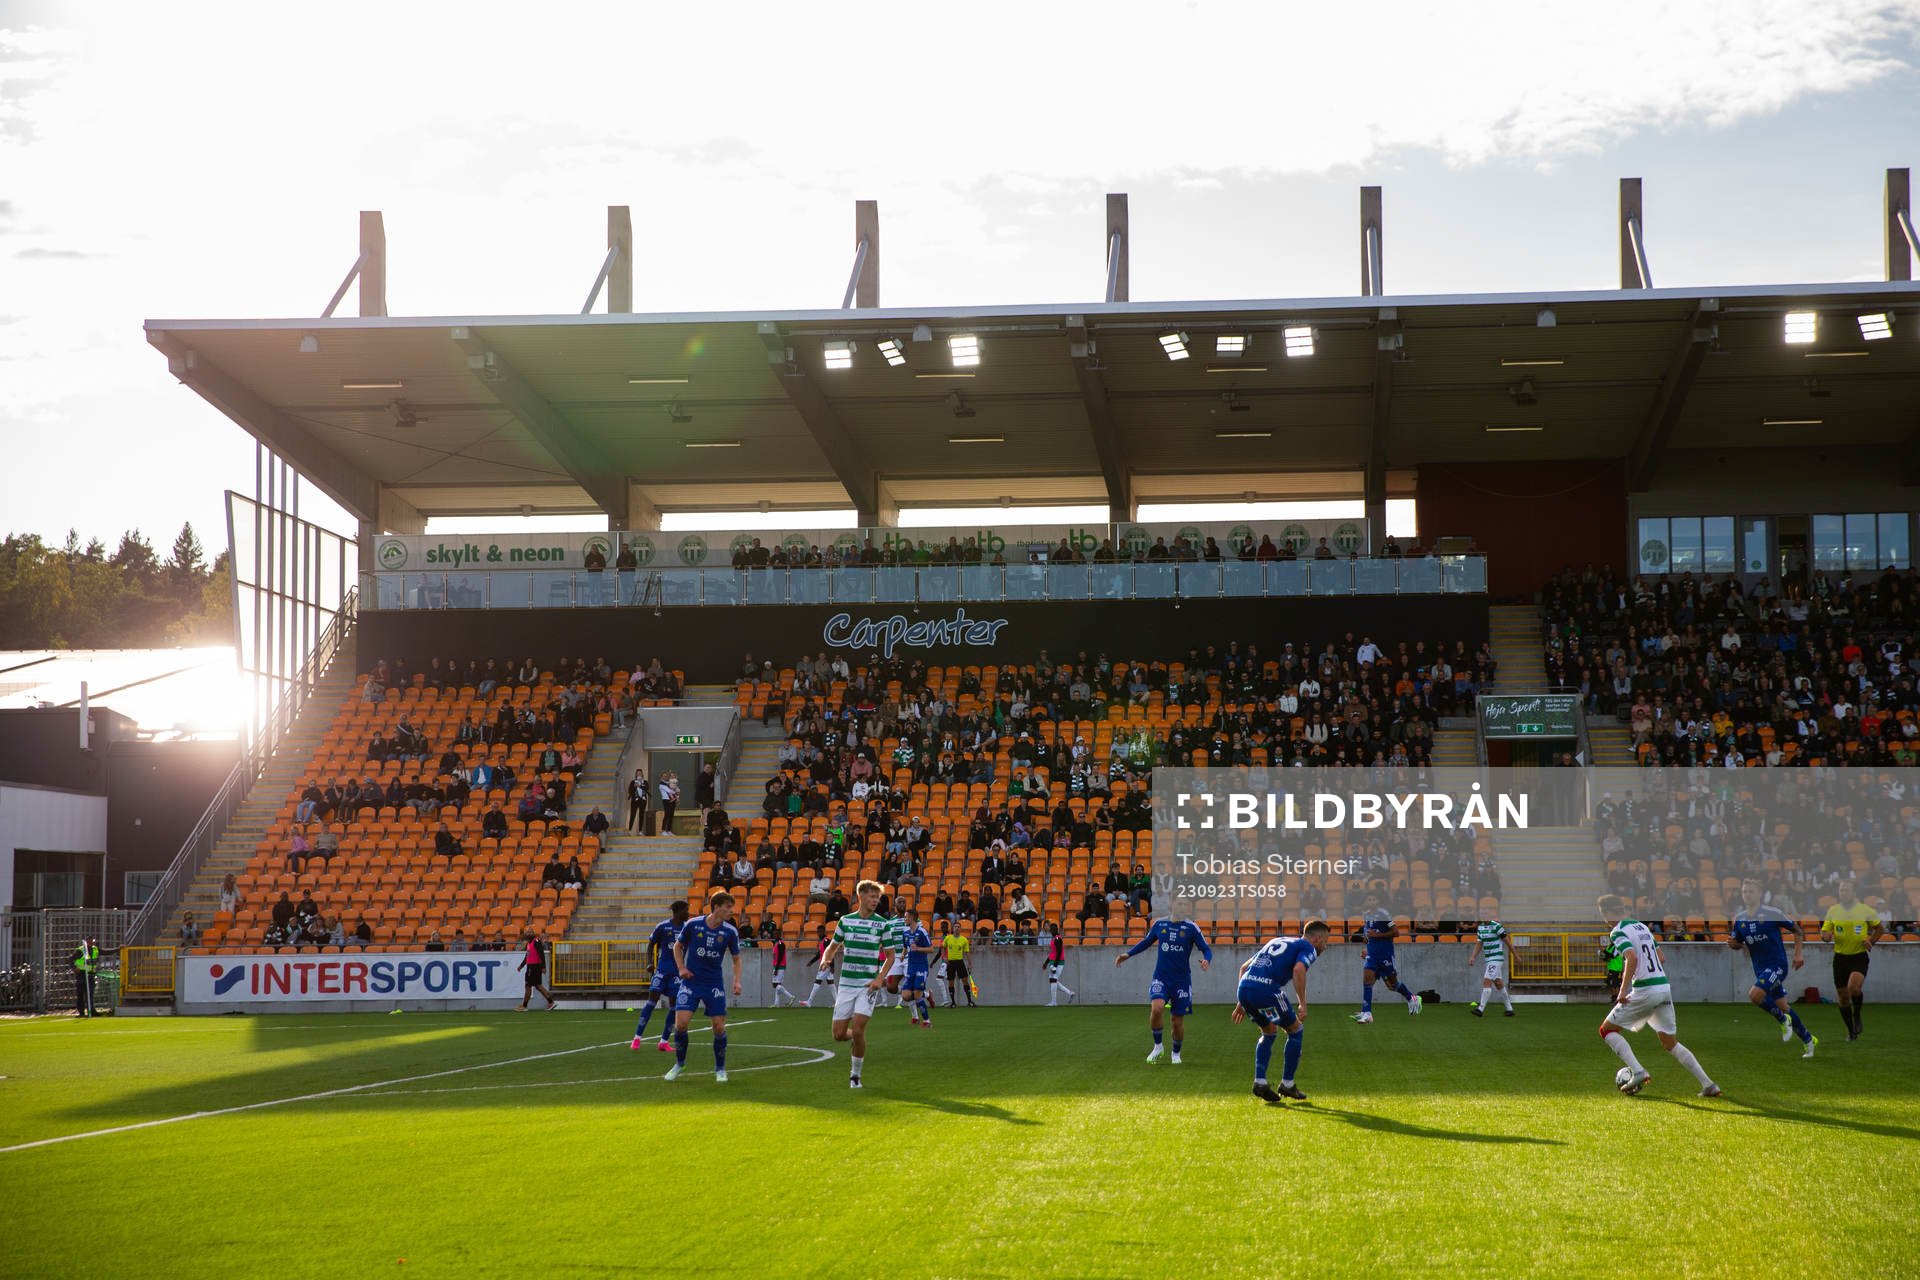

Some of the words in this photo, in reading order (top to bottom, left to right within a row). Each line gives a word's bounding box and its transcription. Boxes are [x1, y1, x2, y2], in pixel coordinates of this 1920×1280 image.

[978, 531, 1005, 554] tb
[1070, 529, 1098, 552] tb
[426, 543, 480, 568] skylt
[486, 544, 503, 562] &
[510, 547, 564, 562] neon
[823, 607, 1008, 659] Carpenter
[1485, 702, 1506, 719] Heja
[706, 950, 720, 958] SCA
[1170, 944, 1184, 952] SCA
[1641, 943, 1662, 973] 31
[251, 960, 501, 996] INTERSPORT
